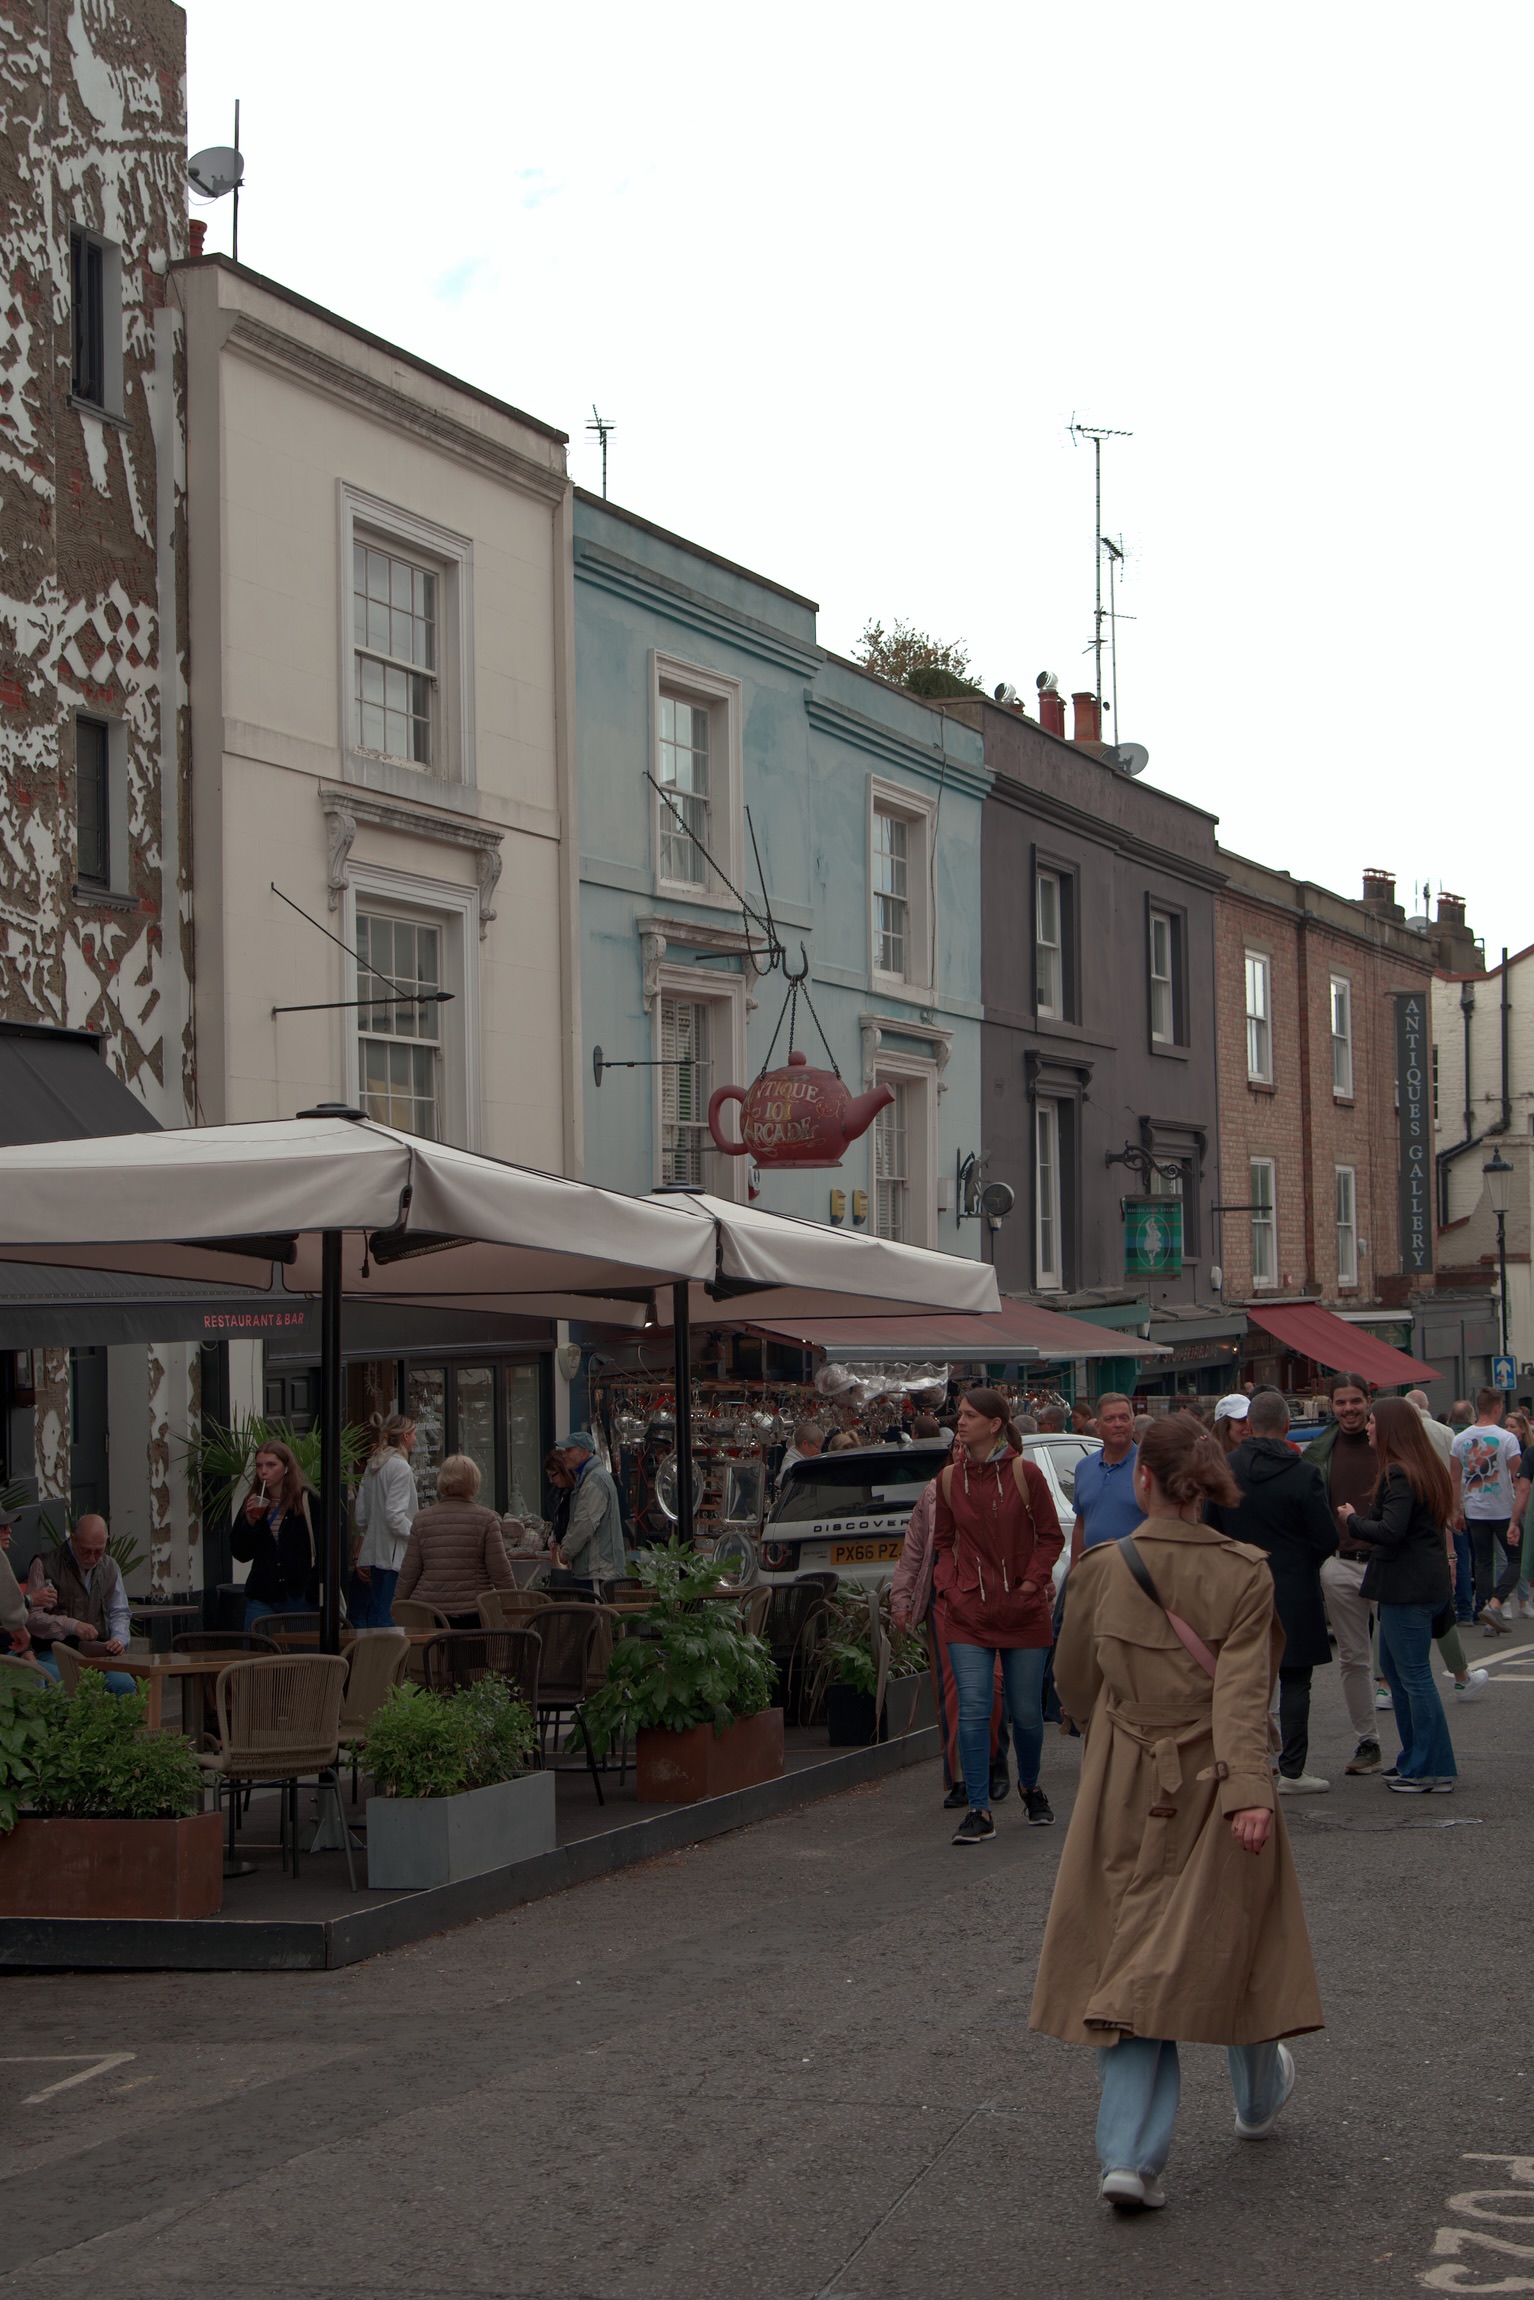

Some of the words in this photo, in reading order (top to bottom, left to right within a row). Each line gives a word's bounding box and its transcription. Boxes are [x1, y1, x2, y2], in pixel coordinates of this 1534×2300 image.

[1405, 999, 1422, 1136] ANTIQUES
[1409, 1145, 1425, 1267] GALLERY
[204, 1314, 274, 1328] RESTAURANT
[276, 1313, 283, 1326] &
[284, 1312, 304, 1325] BAR
[836, 1546, 874, 1562] PX66
[878, 1543, 902, 1559] PZ
